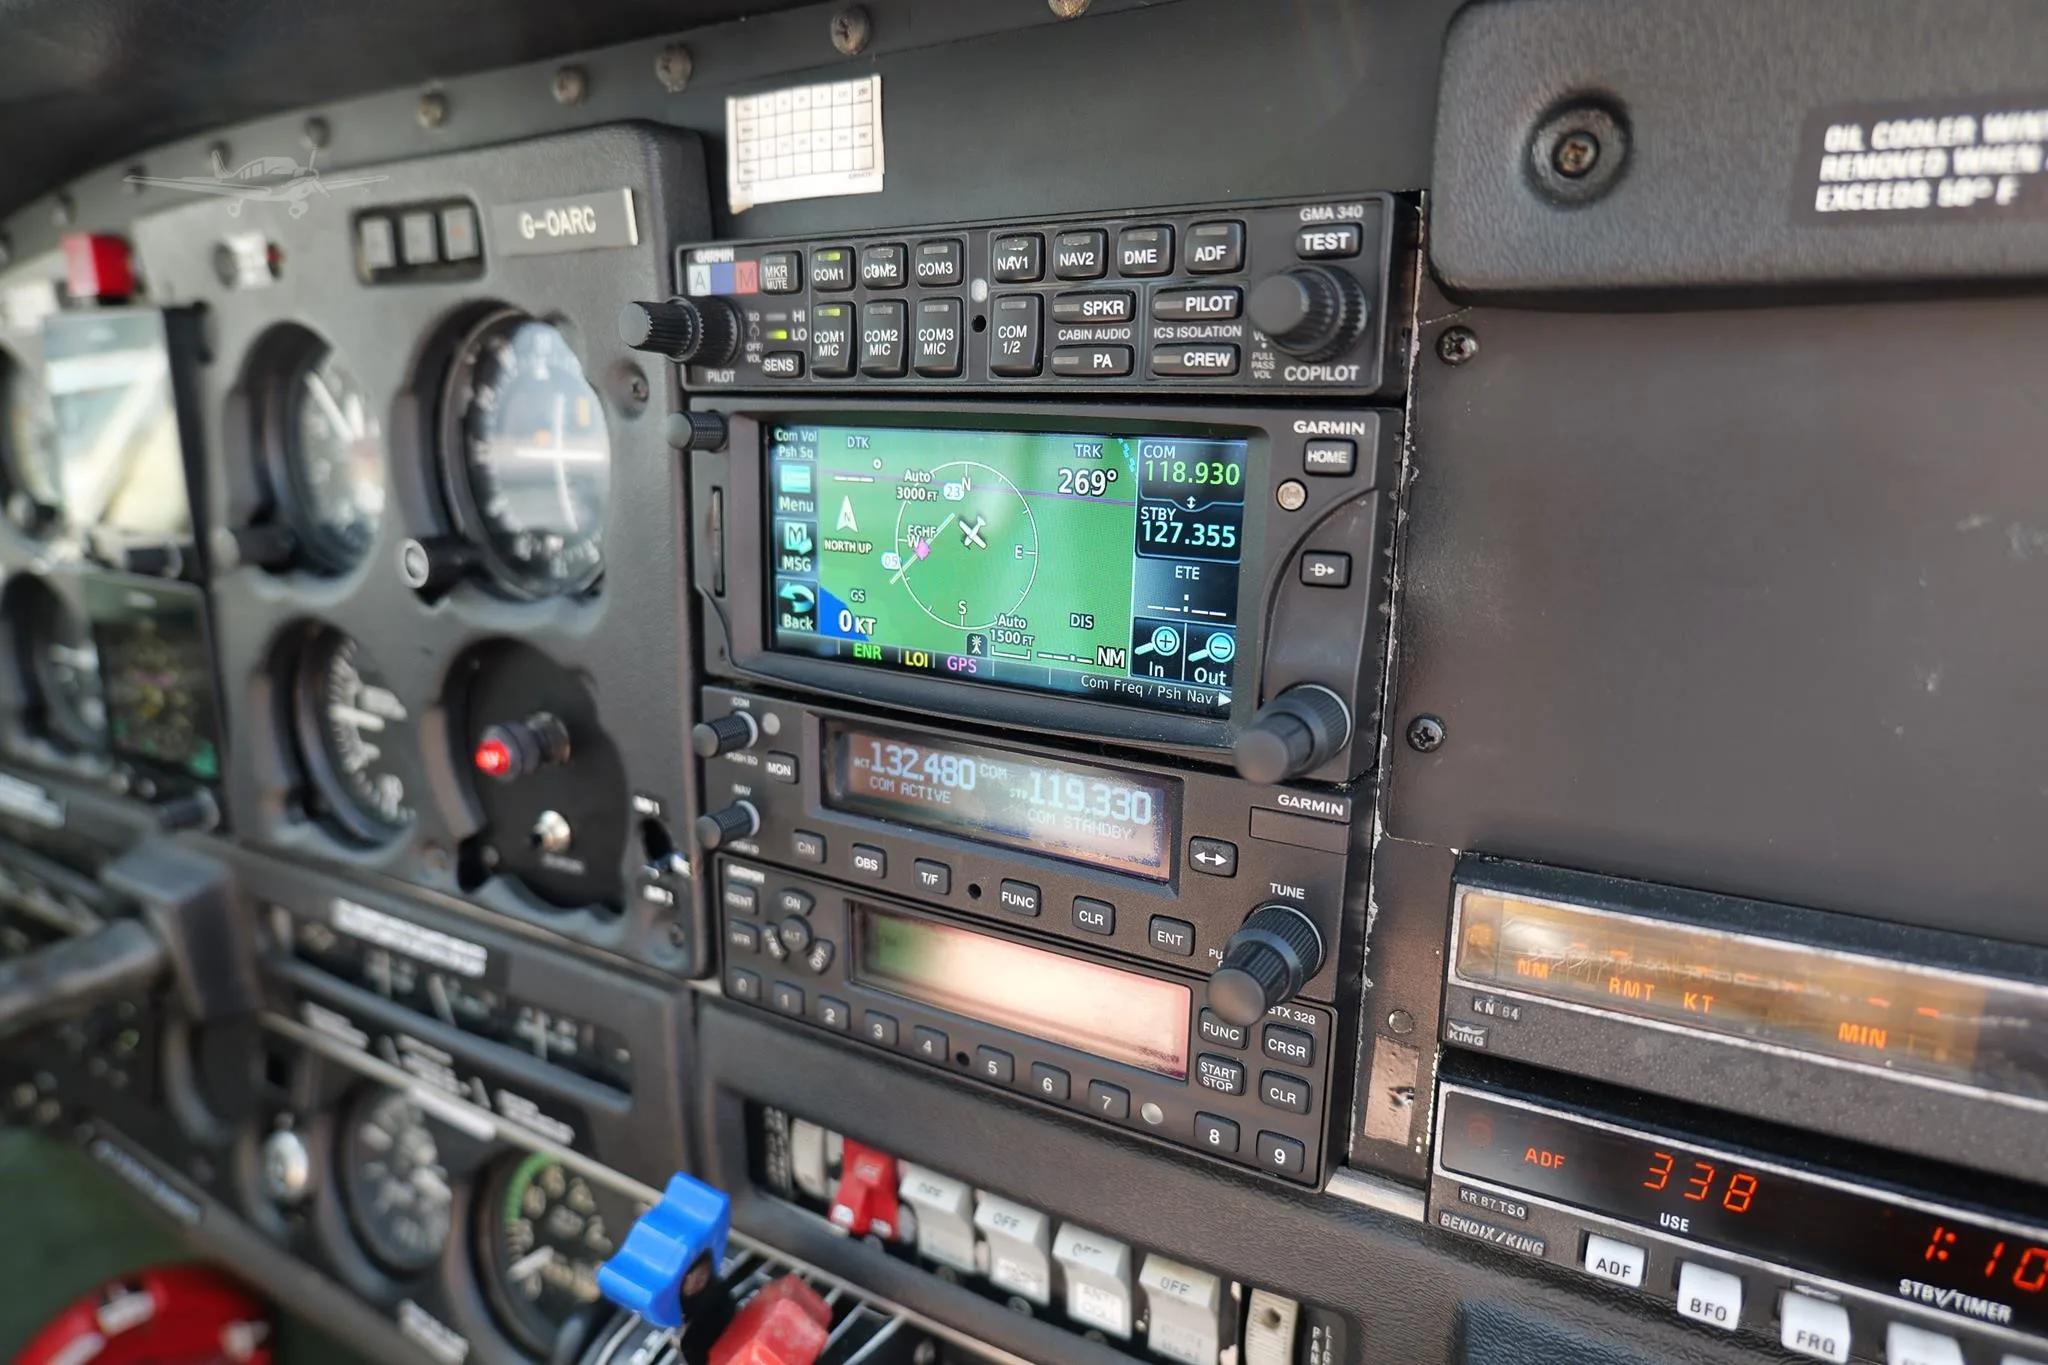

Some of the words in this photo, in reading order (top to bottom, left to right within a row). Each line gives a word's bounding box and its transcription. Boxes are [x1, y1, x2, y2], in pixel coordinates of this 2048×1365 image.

[1299, 206, 1334, 222] GMA
[1336, 204, 1363, 219] 340
[520, 206, 596, 239] G-OARC
[1302, 232, 1351, 250] TEST
[1059, 251, 1095, 267] NAV2
[1124, 249, 1157, 265] DME
[1194, 246, 1227, 262] ADF
[863, 263, 897, 279] COM2
[917, 262, 953, 277] COM3
[997, 255, 1029, 271] NAV1
[765, 264, 788, 279] MKR
[813, 267, 844, 281] COM1
[766, 279, 788, 290] MUTE
[1082, 300, 1125, 316] SPKR
[1185, 295, 1234, 312] PILOT
[792, 310, 806, 323] HI
[792, 328, 807, 341] LO
[814, 330, 845, 344] COM1
[864, 330, 898, 343] COM2
[918, 328, 954, 342] COM3
[997, 325, 1027, 340] COM
[1058, 328, 1088, 340] CABIN
[1091, 327, 1131, 340] AUDIO
[1153, 327, 1174, 339] ICS
[1176, 324, 1242, 339] ISOLATION
[818, 344, 839, 357] MIC
[869, 343, 891, 356] MIC
[923, 342, 946, 356] MIC
[1001, 341, 1020, 355] 1/2
[764, 357, 795, 372] SENS
[1092, 353, 1113, 369] PA
[1183, 351, 1231, 367] CREW
[707, 370, 736, 383] PILOT
[1284, 365, 1360, 381] COPILOT
[1293, 419, 1366, 435] GARMIN
[775, 428, 800, 442] Com
[801, 429, 817, 443] Vol
[847, 436, 870, 449] DTK
[778, 446, 797, 459] Psh
[1074, 443, 1102, 459] TRK
[1144, 445, 1176, 459] COM
[1307, 448, 1348, 465] HOME
[904, 469, 931, 483] Auto
[1144, 459, 1240, 487] 118.930
[1058, 468, 1118, 497] 269°
[896, 487, 926, 501] 3000
[927, 491, 939, 502] FT
[778, 497, 814, 512] Menu
[1140, 506, 1177, 522] STBY
[1142, 521, 1236, 549] 127.355
[824, 539, 856, 553] NORTH
[858, 542, 872, 555] UP
[1014, 546, 1024, 560] E
[782, 556, 811, 572] MSG
[1175, 565, 1200, 581] ETE
[850, 589, 866, 602] GS
[958, 601, 967, 615] S
[782, 614, 813, 630] Back
[838, 609, 852, 633] 0
[854, 616, 877, 635] KT
[998, 614, 1027, 629] Auto
[1070, 613, 1094, 629] DIS
[990, 629, 1021, 645] 1500
[1022, 635, 1034, 647] FT
[853, 643, 882, 660] ENR
[905, 651, 928, 668] LOI
[1096, 646, 1126, 669] NM
[946, 656, 977, 674] GPS
[1149, 661, 1164, 678] In
[1194, 666, 1227, 686] Out
[1081, 674, 1110, 690] Com
[1114, 679, 1143, 698] Freq
[1157, 685, 1182, 699] Psh
[1186, 689, 1213, 704] Nav
[766, 761, 792, 777] MON
[869, 740, 977, 792] 132.480
[869, 775, 899, 793] COM
[900, 783, 952, 806] ACTIVE
[1027, 770, 1152, 826] 119.330
[1278, 794, 1344, 816] GARMIN
[1027, 807, 1056, 826] COM
[1063, 815, 1133, 842] STANDBY
[855, 855, 878, 871] OBS
[921, 871, 939, 886] T/F
[1269, 882, 1305, 899] TUNE
[784, 895, 801, 910] ON
[1001, 890, 1035, 909] FUNC
[1078, 910, 1104, 926] CLR
[1157, 929, 1184, 946] ENT
[1517, 957, 1551, 981] NM
[1609, 977, 1656, 1002] RMT
[1474, 1000, 1495, 1016] KN
[1683, 991, 1714, 1015] KT
[824, 1007, 835, 1024] 2
[1293, 1010, 1316, 1026] 328
[873, 1023, 883, 1037] 3
[1202, 1021, 1240, 1042] FUNC
[1838, 1022, 1887, 1049] MIN
[922, 1039, 933, 1053] 4
[1267, 1038, 1307, 1059] CRSR
[1449, 1030, 1485, 1051] KING
[987, 1060, 998, 1075] 5
[1200, 1061, 1238, 1080] START
[1042, 1077, 1053, 1092] 6
[1202, 1076, 1235, 1093] STOP
[1102, 1095, 1112, 1109] 7
[1269, 1087, 1298, 1105] CLR
[1209, 1128, 1220, 1145] 8
[1274, 1148, 1286, 1165] 9
[1525, 1147, 1566, 1170] ADF
[1643, 1151, 1758, 1214] 338
[1460, 1188, 1477, 1205] KR
[1481, 1193, 1495, 1209] 87
[1499, 1201, 1526, 1219] TSO
[1659, 1212, 1690, 1234] USE
[1440, 1213, 1545, 1257] BENDIX/KING
[1595, 1257, 1632, 1281] ADF
[1160, 1276, 1191, 1296] OFF
[1899, 1279, 2012, 1324] STBY/TIMER
[1796, 1330, 1836, 1356] FRQ
